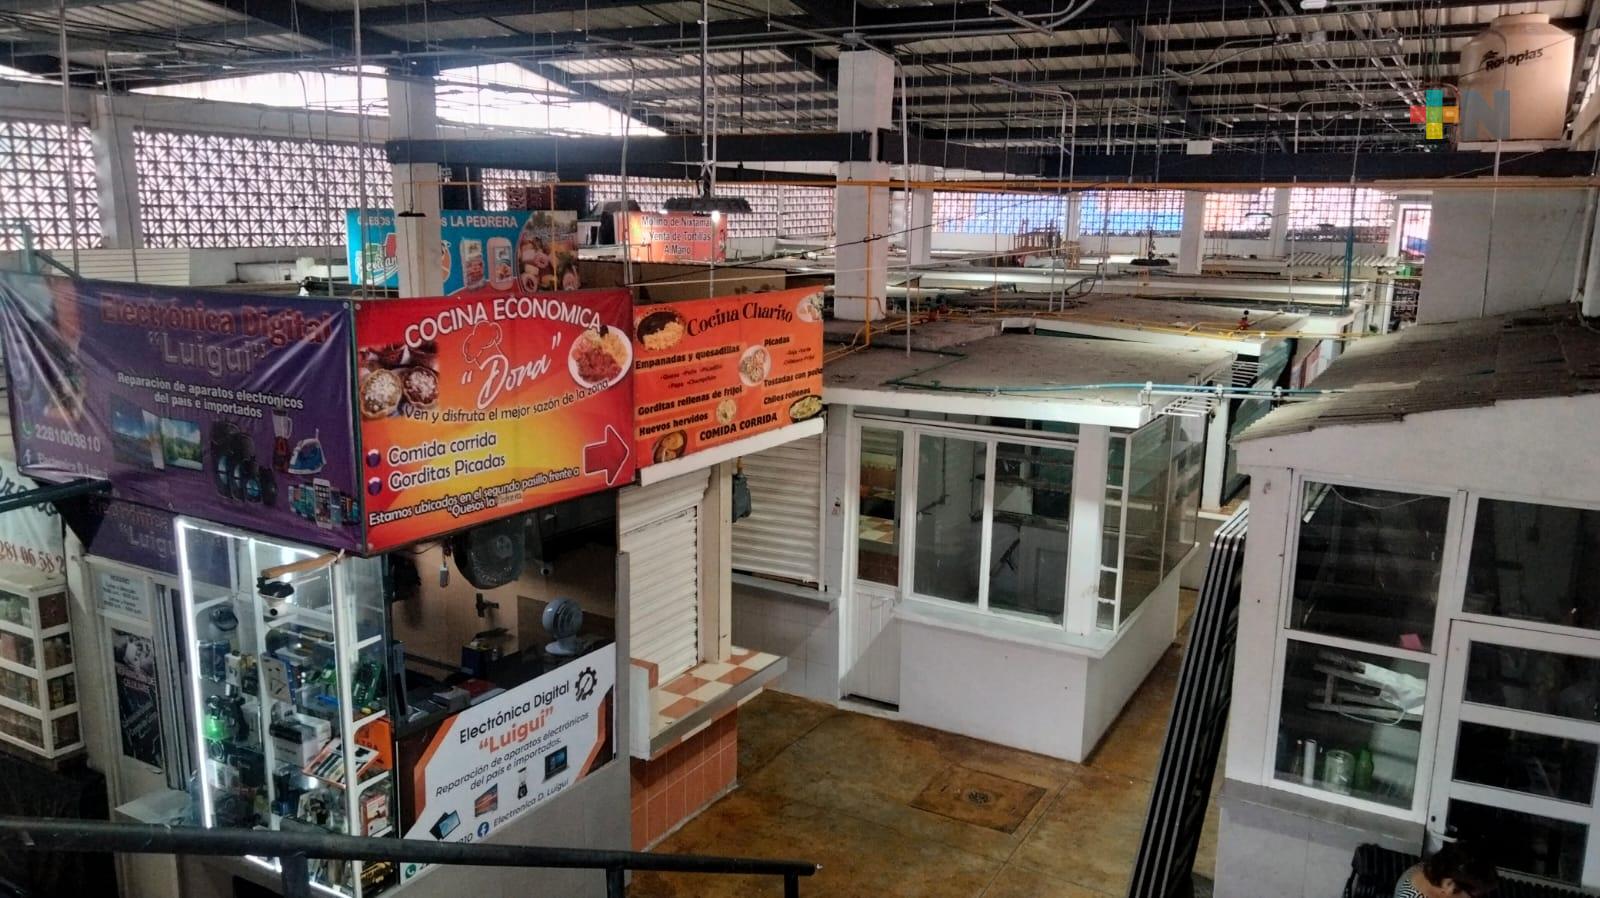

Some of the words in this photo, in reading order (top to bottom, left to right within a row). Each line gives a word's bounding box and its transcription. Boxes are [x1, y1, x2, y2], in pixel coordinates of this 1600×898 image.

[357, 216, 391, 227] QESOS
[450, 215, 465, 228] LA
[466, 215, 519, 229] PEDRERA
[671, 216, 680, 226] de
[672, 244, 691, 255] Mano
[673, 231, 682, 241] de
[101, 296, 234, 335] Electrónica
[241, 305, 332, 347] Digital
[404, 302, 489, 349] COCINA
[493, 297, 602, 333] ECONOMICA
[687, 308, 740, 337] Cocina
[742, 302, 793, 323] Charito
[764, 336, 790, 347] Picadas
[635, 354, 687, 370] Empanadas
[688, 352, 694, 362] y
[695, 345, 740, 360] quesadillas
[117, 372, 171, 391] Reparación
[173, 379, 186, 392] de
[188, 382, 234, 401] aparatos
[237, 389, 304, 410] electrónicos
[764, 375, 793, 387] Tostadas
[795, 372, 806, 381] con
[154, 391, 169, 404] del
[195, 400, 202, 409] e
[204, 399, 263, 419] importados
[402, 405, 428, 421] Ven
[431, 412, 439, 424] y
[442, 408, 486, 423] disfruta
[489, 407, 498, 421] el
[501, 406, 530, 423] mejor
[533, 398, 560, 416] sazón
[562, 392, 575, 405] de
[576, 389, 586, 402] la
[587, 380, 609, 396] zona
[638, 402, 675, 416] Gorditas
[677, 393, 710, 408] rellenas
[712, 390, 722, 400] de
[723, 385, 743, 398] frijol
[763, 394, 784, 405] Chiles
[640, 422, 671, 437] Huevos
[673, 412, 709, 428] hervidos
[700, 422, 737, 442] COMIDA
[739, 412, 778, 431] CORRIDA
[388, 440, 446, 465] Comida
[450, 432, 497, 453] corrida
[389, 467, 451, 490] Gorditas
[454, 453, 506, 474] Picadas
[369, 508, 413, 526] Estamos
[415, 497, 458, 514] ubicados
[459, 493, 472, 504] en
[473, 488, 483, 500] el
[483, 482, 521, 499] segundo
[522, 474, 548, 490] pasillo
[549, 466, 573, 483] frente
[572, 468, 580, 477] a
[486, 498, 496, 508] la
[459, 701, 531, 744] Electrónica
[533, 680, 570, 708] Digital
[435, 760, 489, 798] Reparación
[491, 755, 503, 768] de
[503, 736, 542, 762] aparatos
[542, 711, 590, 742] electrónicos
[470, 776, 485, 791] del
[506, 763, 512, 771] e
[547, 778, 569, 797] Luigui
